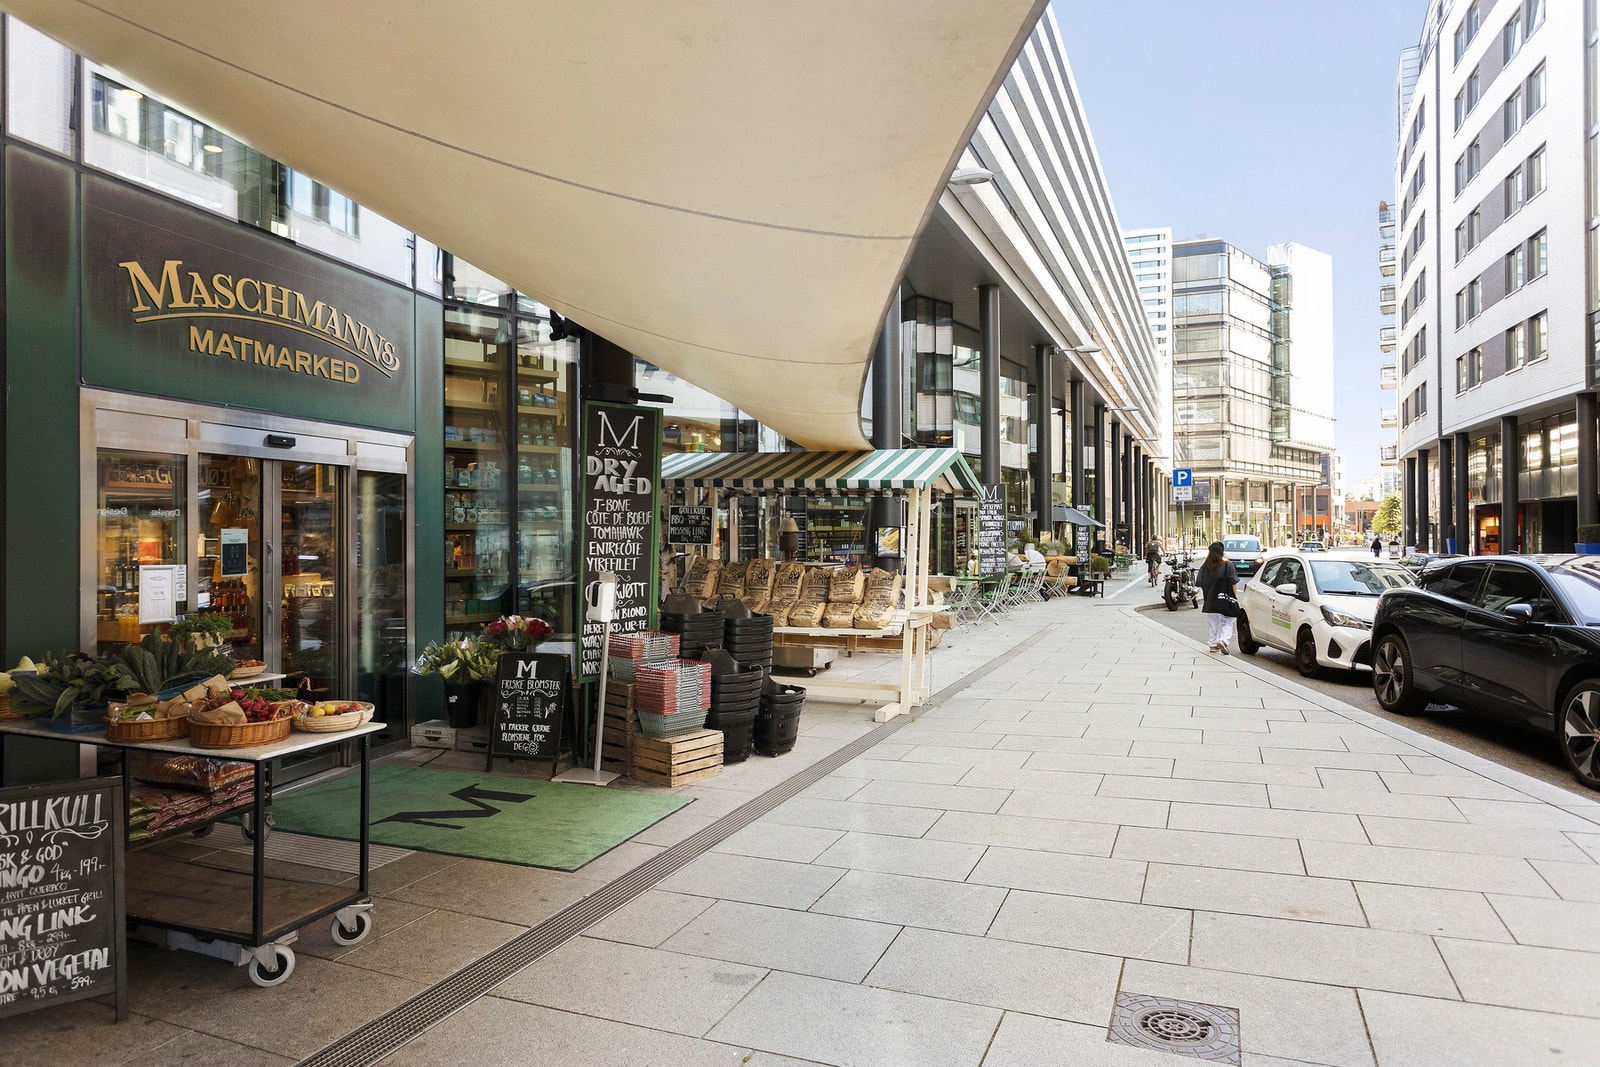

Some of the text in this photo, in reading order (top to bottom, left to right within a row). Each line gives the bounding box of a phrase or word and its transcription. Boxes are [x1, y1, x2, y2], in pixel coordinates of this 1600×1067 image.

[118, 259, 400, 371] MASCHMANNS
[189, 325, 360, 384] MATMARKED
[598, 411, 644, 449] M
[586, 455, 638, 480] DRY
[594, 474, 652, 495] AGED
[1178, 471, 1188, 485] P
[593, 498, 632, 512] T-BONE
[586, 509, 652, 526] CÔTE DE BOEUF
[671, 515, 684, 524] BBQ
[590, 526, 644, 540] TOMAHAWK
[692, 527, 707, 535] LINK
[589, 540, 643, 556] ENTRECÔTE
[586, 557, 640, 572] YTREFILET
[516, 660, 538, 679] M
[501, 680, 561, 690] FRISKE BLOMSTER
[500, 723, 506, 731] VI
[533, 733, 547, 742] FOR
[21, 849, 33, 865] &
[37, 904, 97, 935] LINK
[32, 947, 112, 986] VEGETAL
